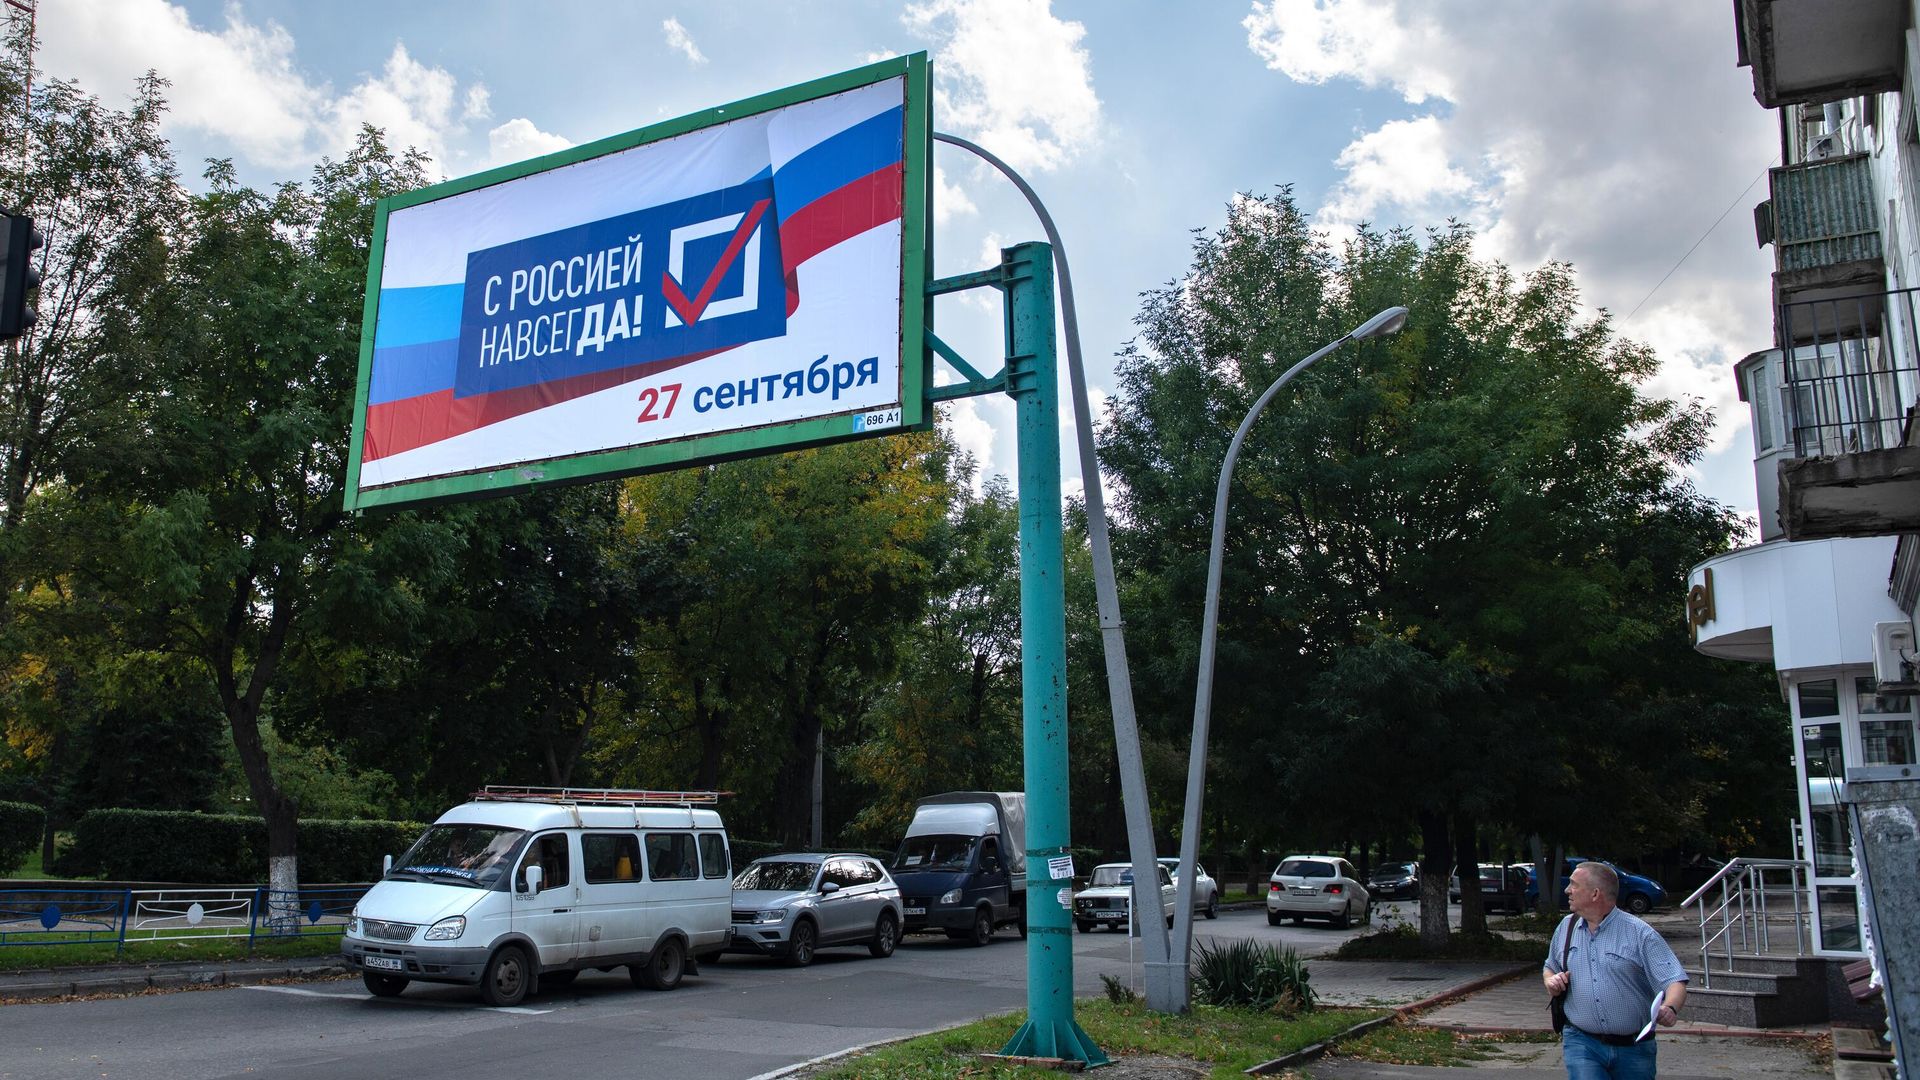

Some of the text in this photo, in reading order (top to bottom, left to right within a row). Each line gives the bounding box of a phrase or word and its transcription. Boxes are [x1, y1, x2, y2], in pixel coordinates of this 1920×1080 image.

[484, 233, 643, 316] С РОССИЕЙ
[479, 294, 643, 368] НАВСЕГДА!
[637, 354, 879, 423] 27 сентября
[866, 414, 884, 426] 696
